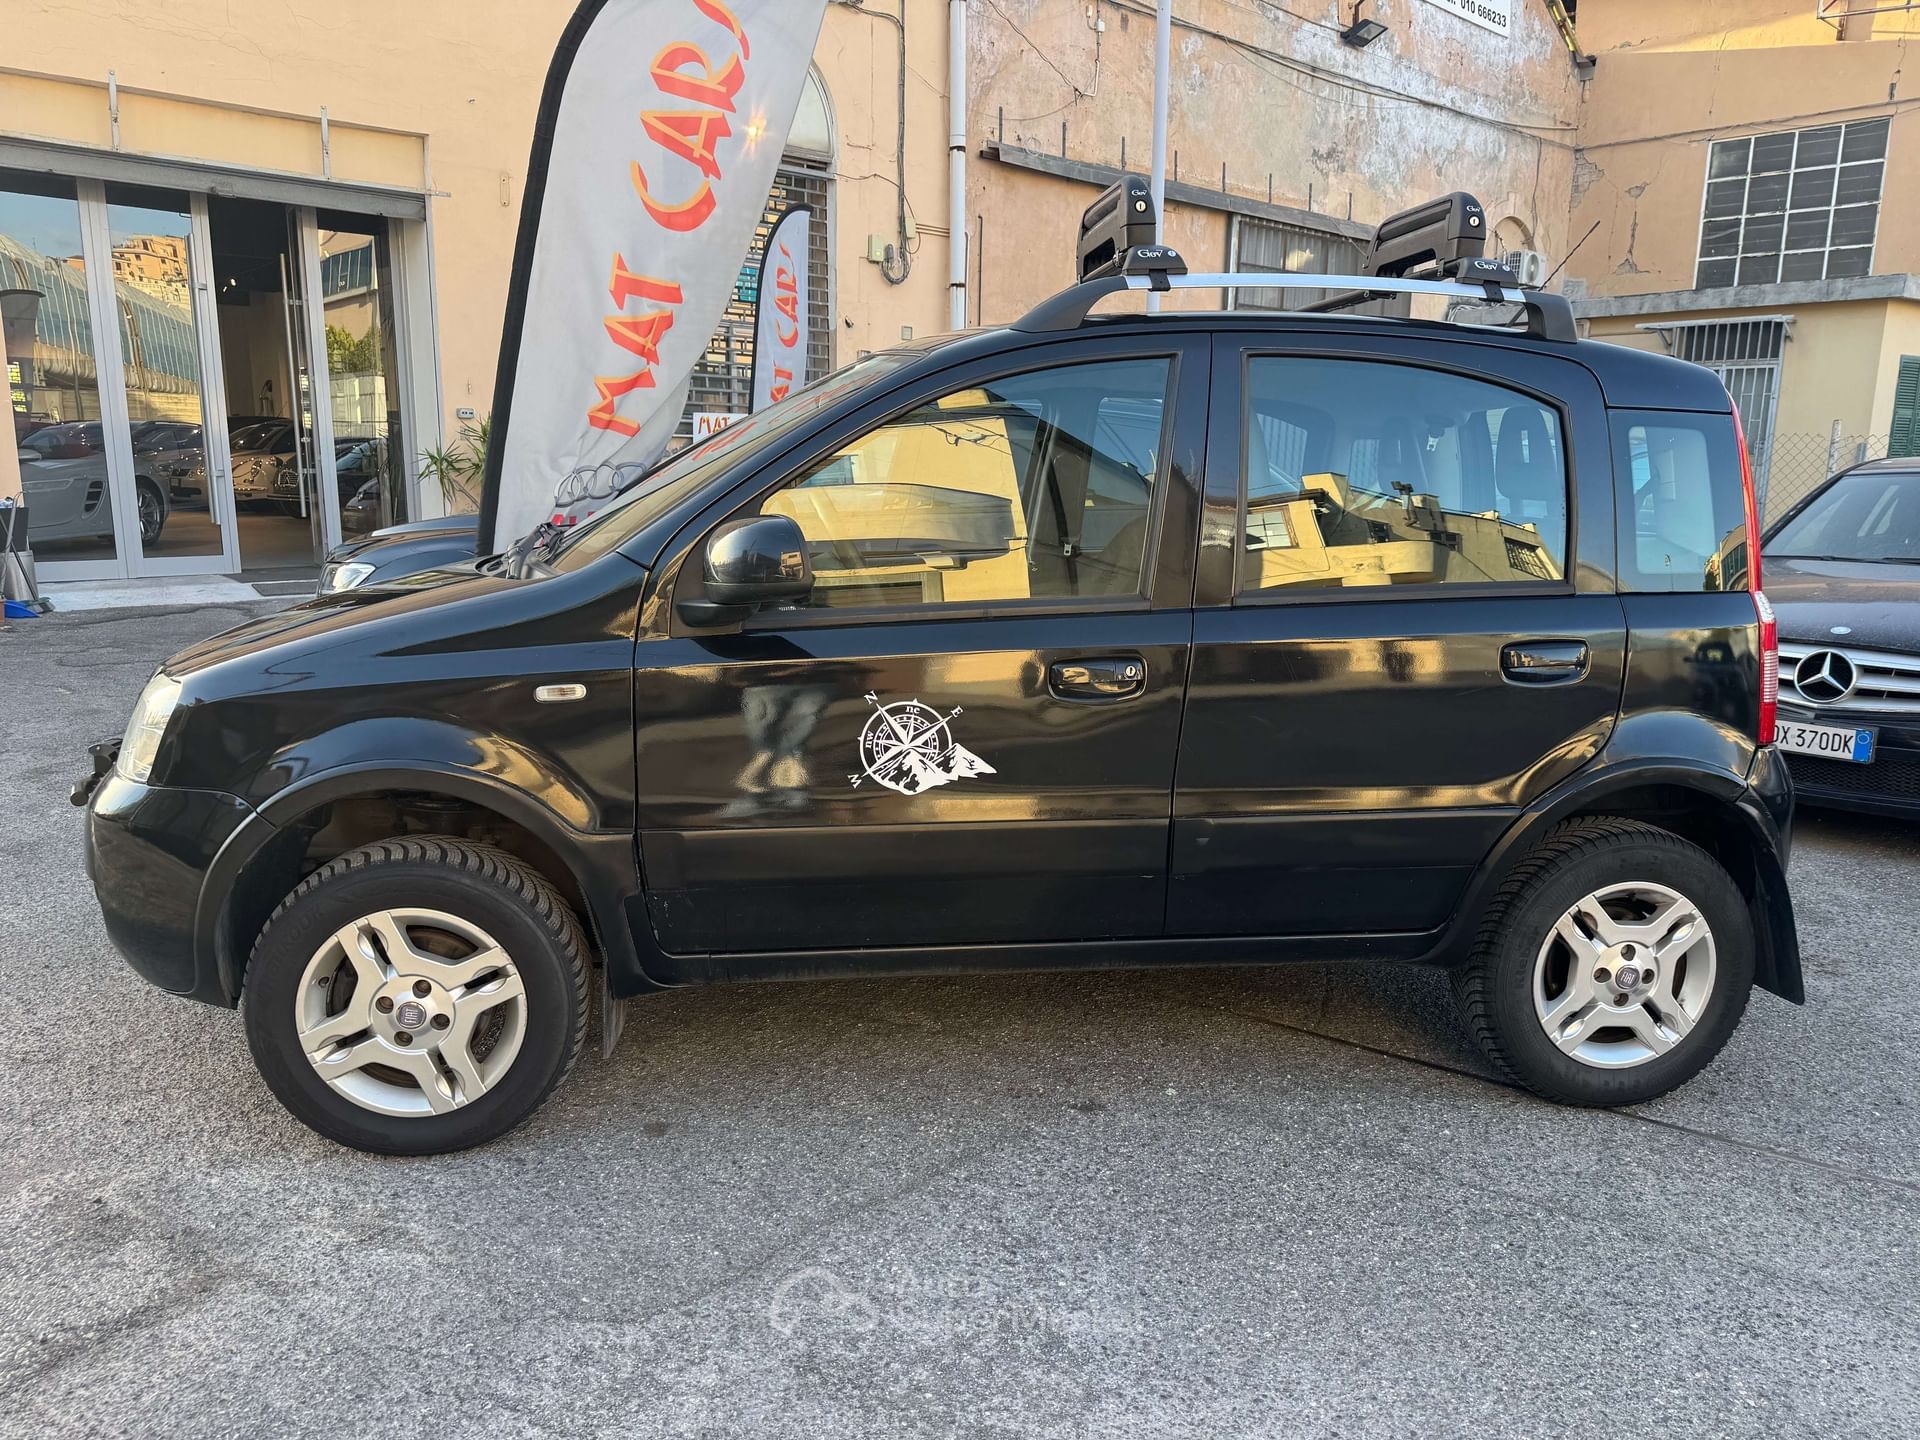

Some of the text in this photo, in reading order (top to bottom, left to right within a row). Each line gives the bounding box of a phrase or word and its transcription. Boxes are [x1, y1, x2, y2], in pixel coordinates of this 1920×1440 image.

[1461, 0, 1507, 28] 010 666233
[587, 252, 684, 438] MAT
[770, 359, 793, 403] AT
[864, 690, 878, 705] N
[950, 705, 963, 718] E
[1795, 728, 1853, 754] 370DK
